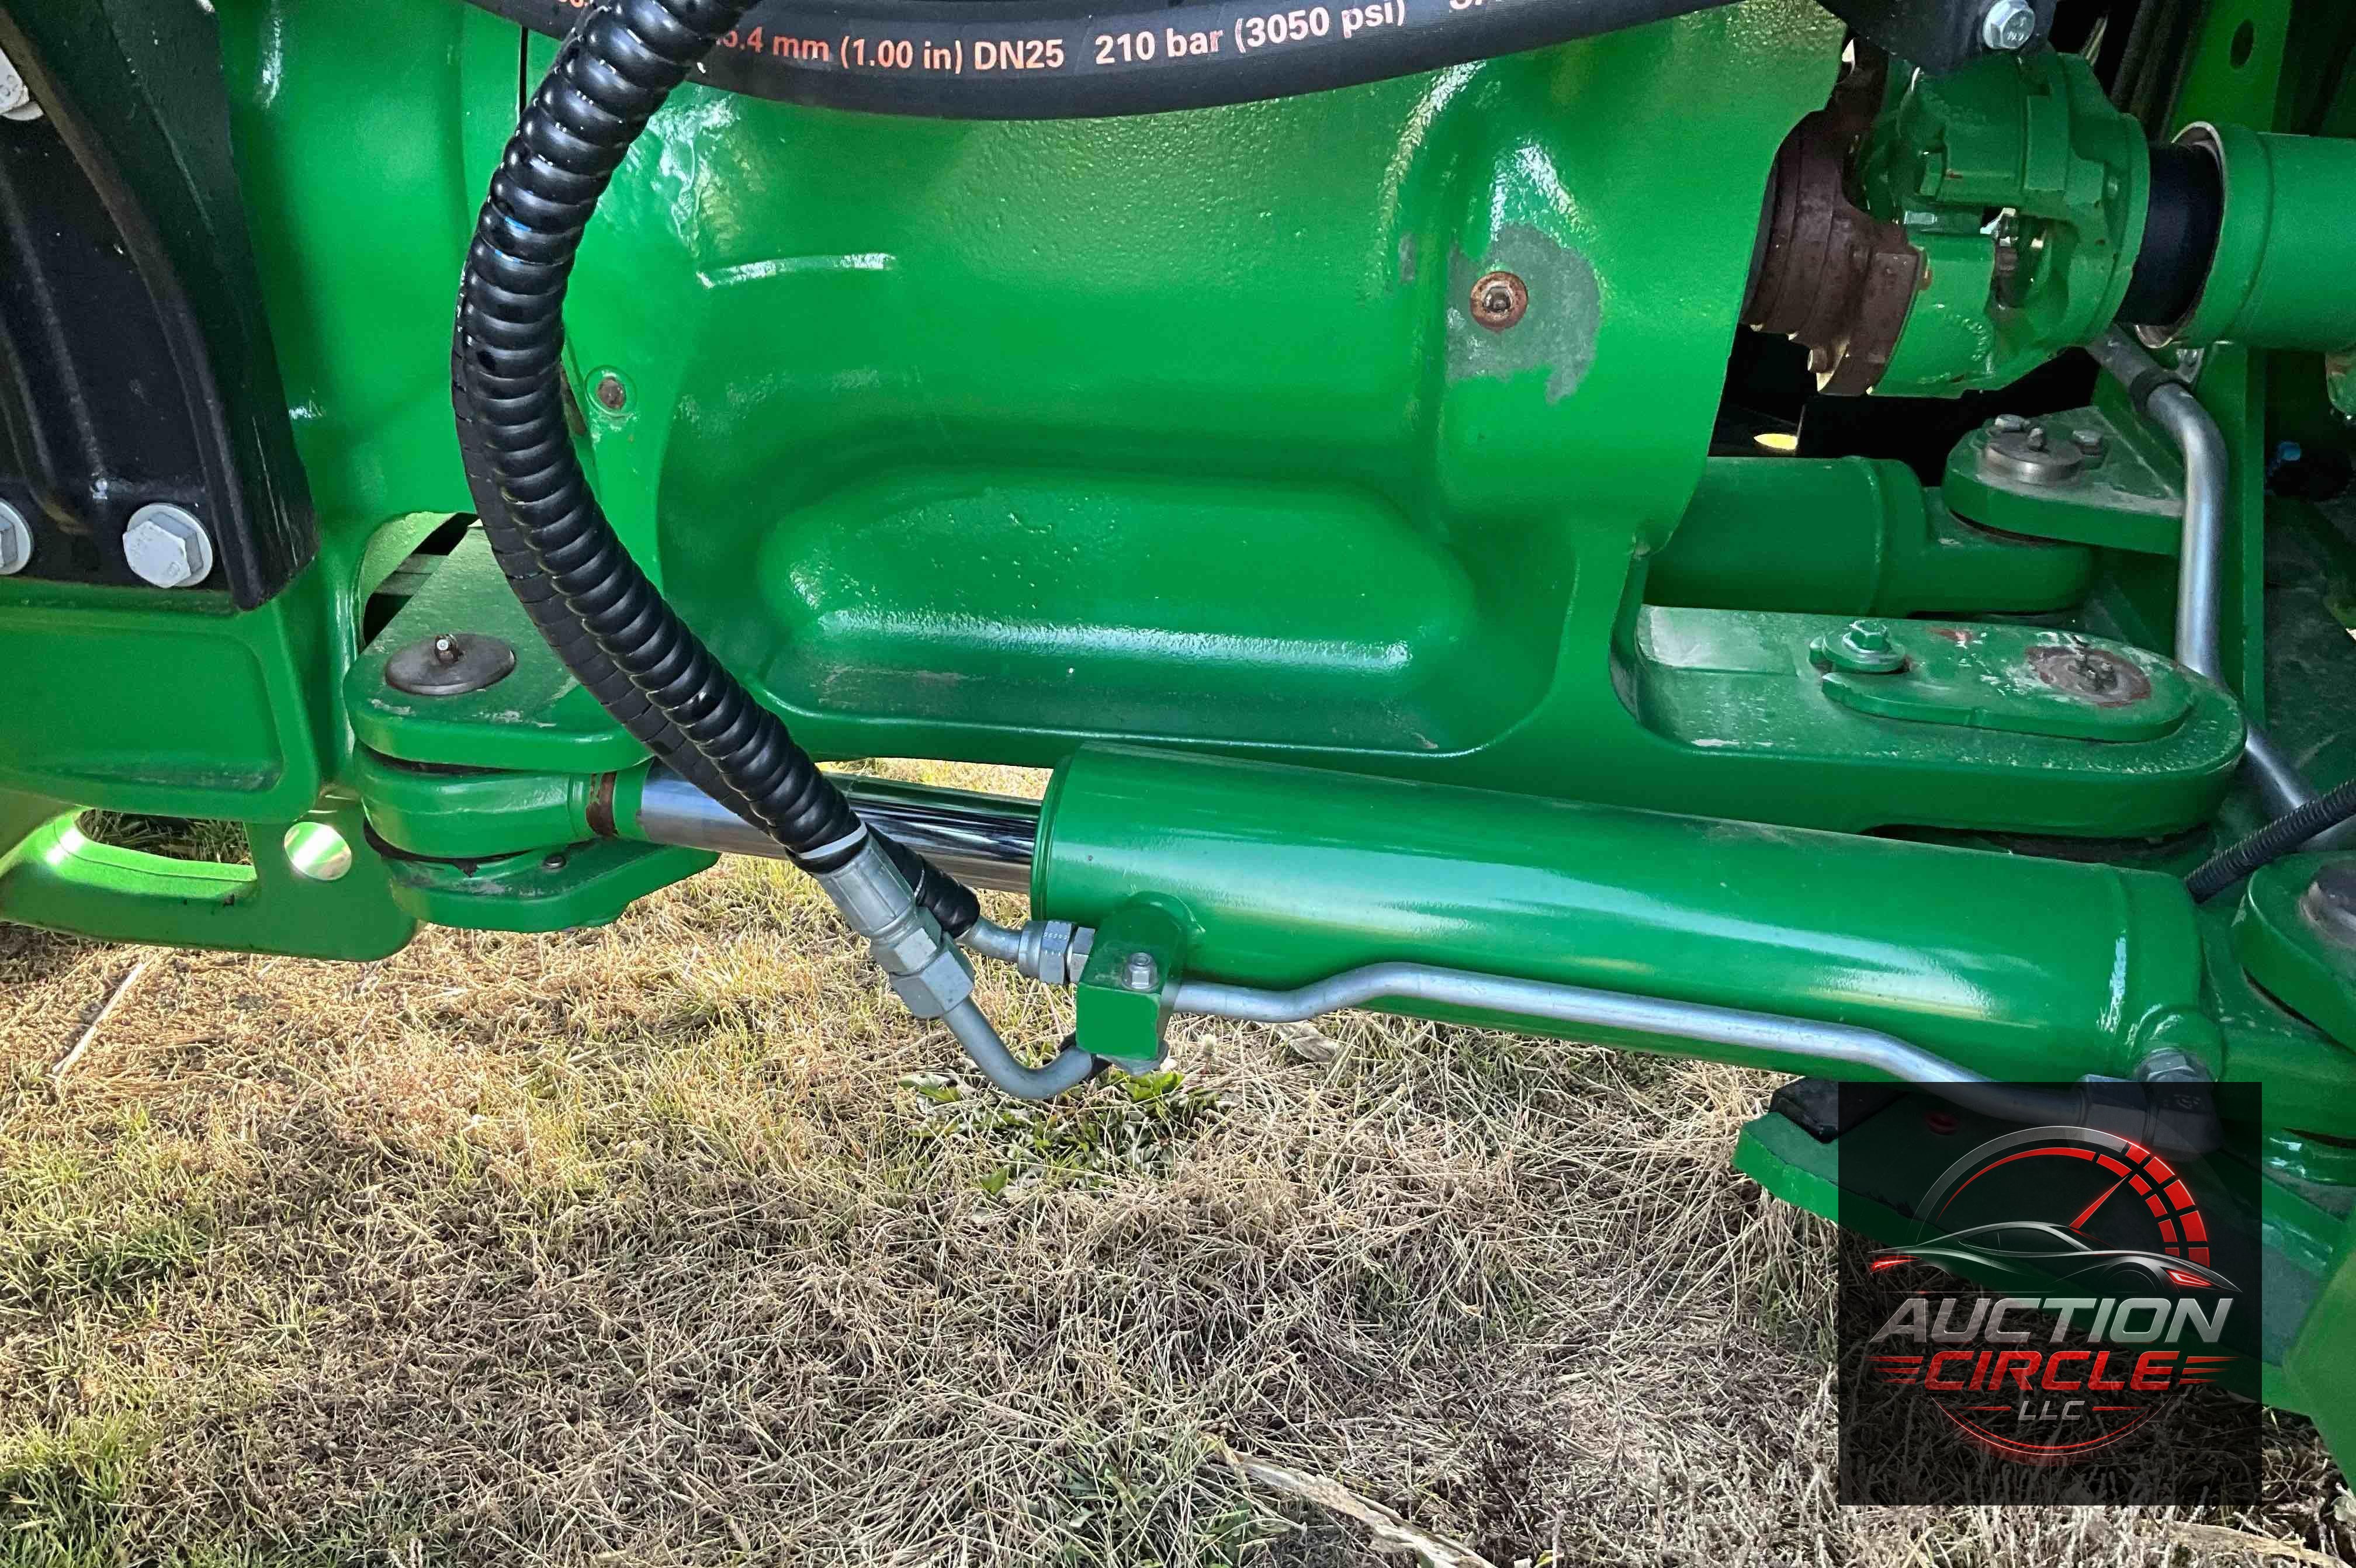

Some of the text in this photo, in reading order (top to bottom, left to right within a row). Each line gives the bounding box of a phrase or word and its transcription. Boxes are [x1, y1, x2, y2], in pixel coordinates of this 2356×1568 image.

[772, 35, 830, 61] mm
[840, 36, 913, 70] (1.00
[923, 40, 963, 75] in)
[974, 39, 1065, 70] DN25
[1095, 31, 1155, 64] 210
[1166, 28, 1224, 57] bar
[1235, 7, 1330, 53] (3050
[1341, 0, 1405, 39] psi)
